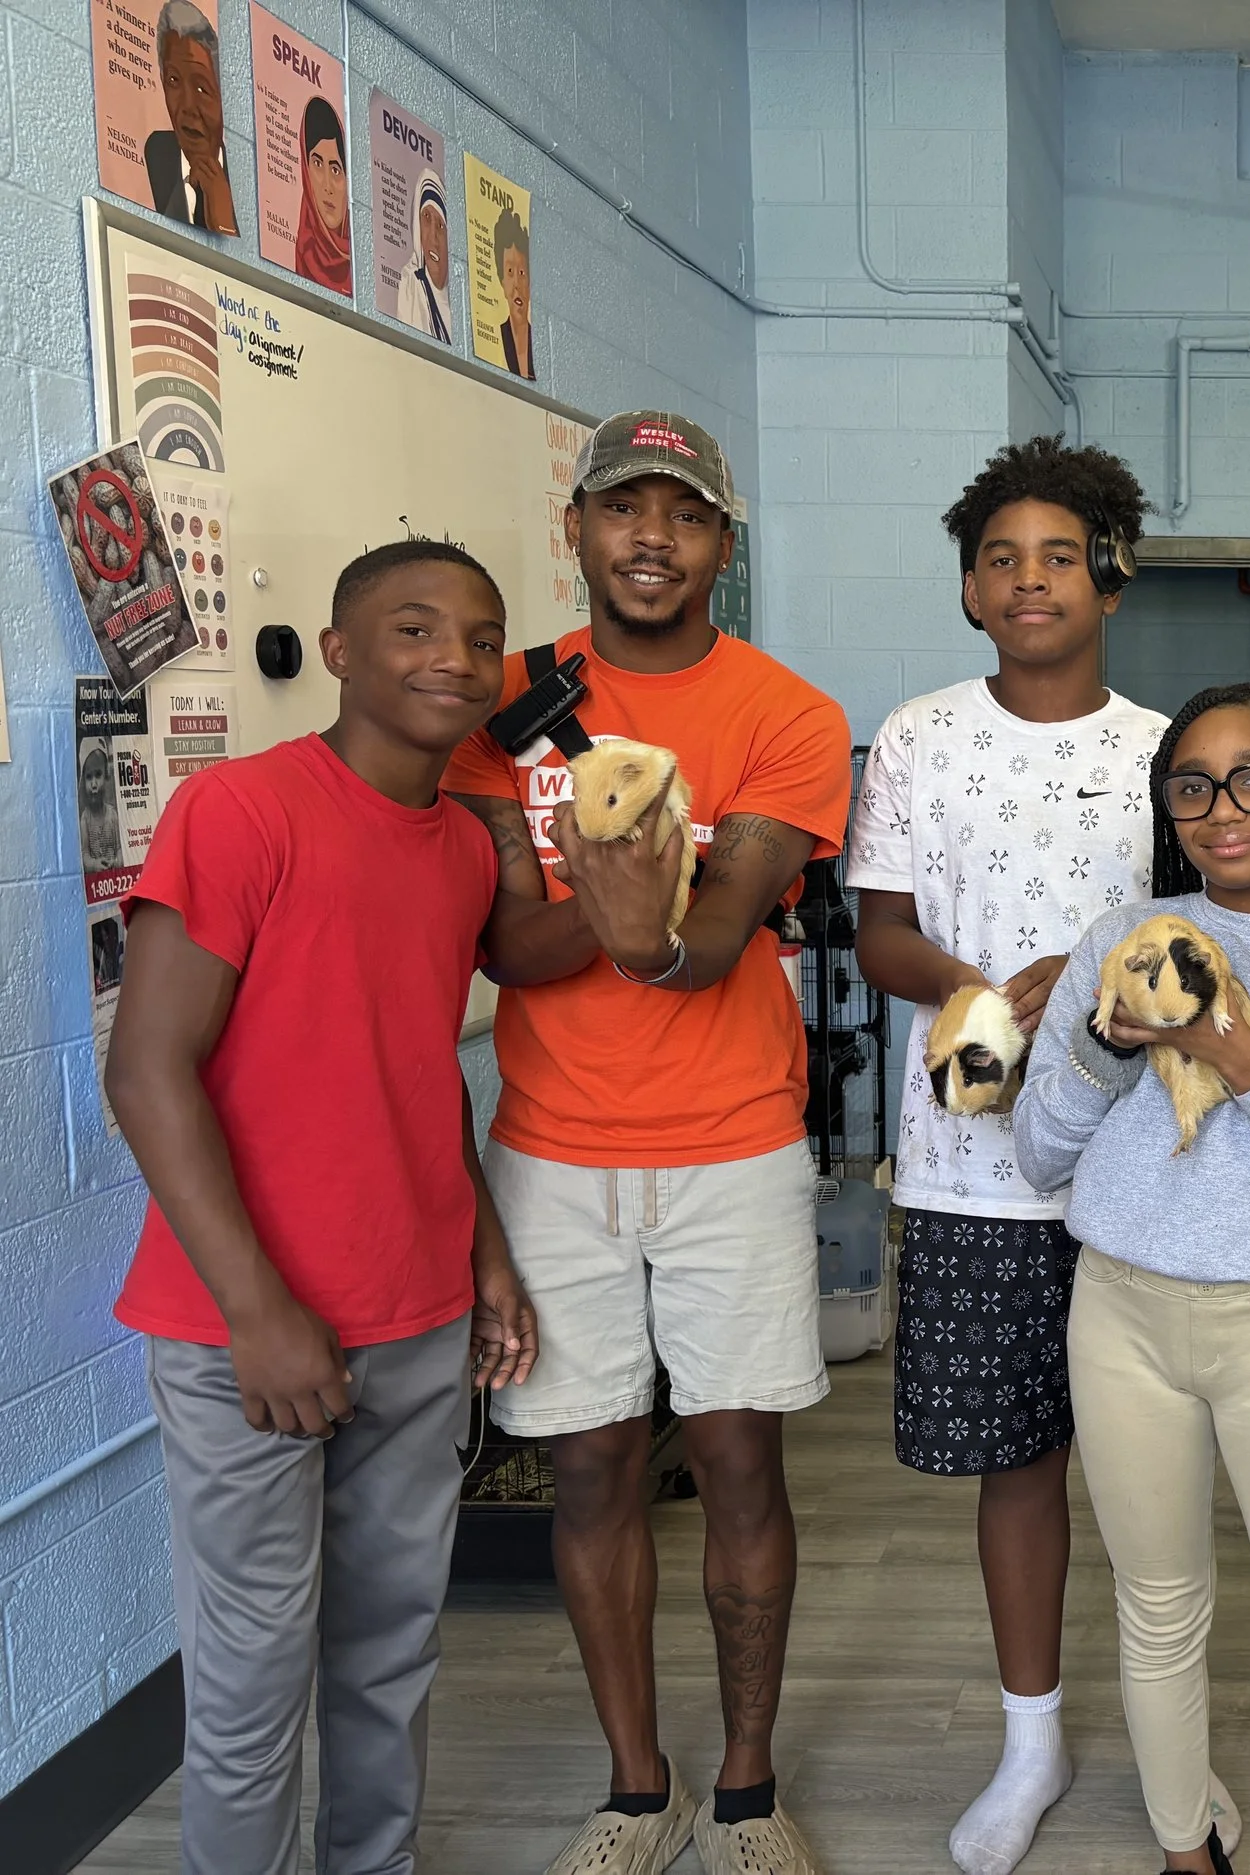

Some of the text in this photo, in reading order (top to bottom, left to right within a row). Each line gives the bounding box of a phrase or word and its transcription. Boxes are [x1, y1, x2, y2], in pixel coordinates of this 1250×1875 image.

[115, 4, 147, 33] winner
[147, 22, 156, 38] is
[106, 19, 151, 53] a dreamer
[107, 38, 152, 73] who never
[272, 33, 322, 89] SPEAK
[108, 59, 131, 80] gives
[264, 101, 290, 123] voice not
[280, 99, 288, 111] my
[265, 114, 271, 123] so
[275, 120, 284, 131] can
[284, 124, 298, 140] shout
[265, 124, 292, 148] but so that
[383, 109, 433, 163] DEVOTE
[107, 126, 137, 149] NELSON
[107, 140, 145, 167] MANDELA
[266, 138, 299, 164] those without
[267, 162, 274, 175] be
[271, 155, 283, 168] voice
[284, 163, 293, 173] can
[479, 176, 514, 213] STAND
[266, 210, 290, 230] MALALA
[381, 264, 402, 281] MOTHER
[214, 281, 245, 317] Word
[265, 310, 281, 333] the
[248, 350, 298, 380] assignment
[175, 433, 183, 444] AM
[632, 438, 669, 447] HOUSE
[640, 428, 684, 442] WESLEY
[170, 493, 176, 504] IS
[190, 495, 196, 507] TO
[197, 498, 208, 511] FEEL
[127, 584, 146, 600] entering
[103, 611, 126, 642] NUT
[123, 598, 149, 629] FREE
[144, 583, 176, 615] ZONE
[80, 686, 98, 700] Know
[99, 686, 114, 700] Your
[170, 696, 194, 711] TODAY
[205, 696, 225, 711] WILL:
[108, 709, 141, 724] Number.
[178, 719, 198, 731] LEARN
[205, 719, 222, 731] GROW
[174, 739, 216, 752] STAY POSITIVE
[117, 751, 132, 761] POISON
[175, 762, 187, 774] SAY
[188, 760, 202, 773] KIND
[126, 801, 148, 811] poison.org
[127, 825, 152, 837] You could
[128, 839, 140, 849] save
